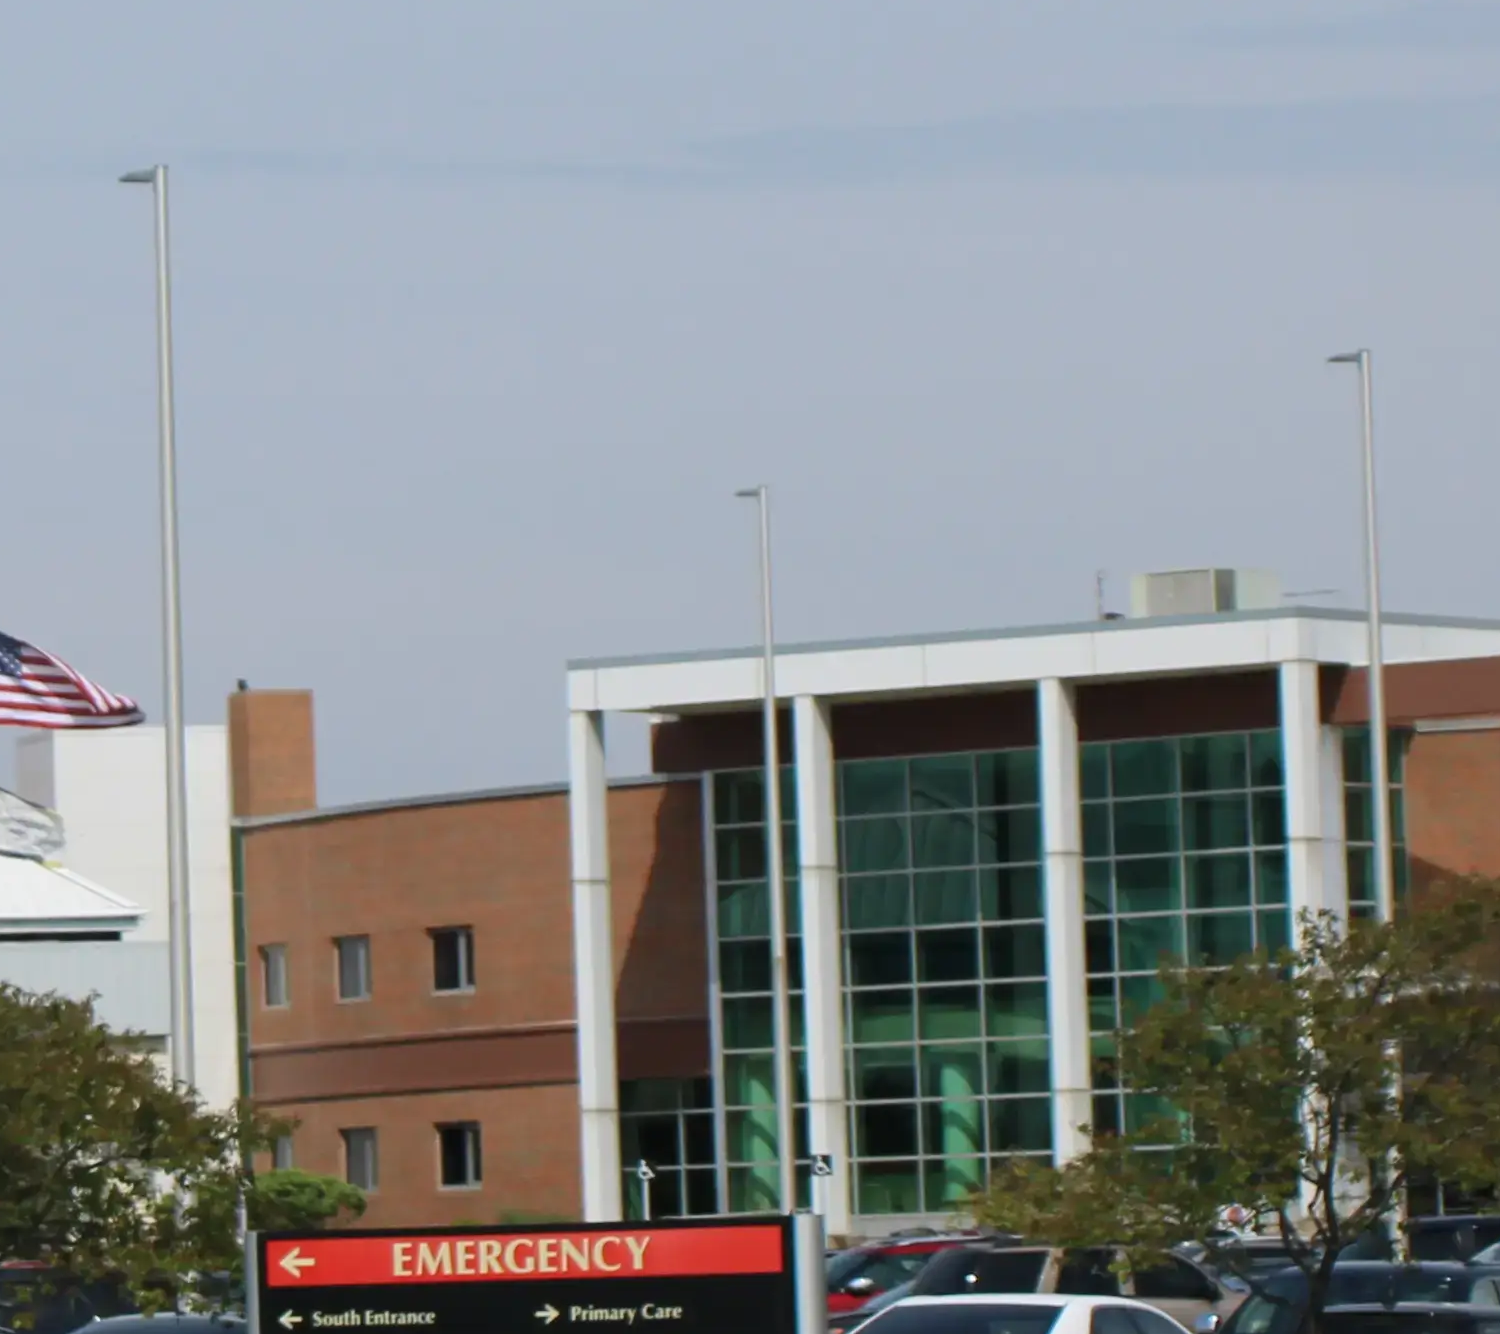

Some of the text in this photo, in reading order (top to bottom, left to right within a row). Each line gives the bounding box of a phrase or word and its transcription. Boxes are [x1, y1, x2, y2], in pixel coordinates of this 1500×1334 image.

[392, 1236, 650, 1276] EMERGENCY
[312, 1310, 436, 1327] South Entrance
[570, 1303, 683, 1325] Primary Care
